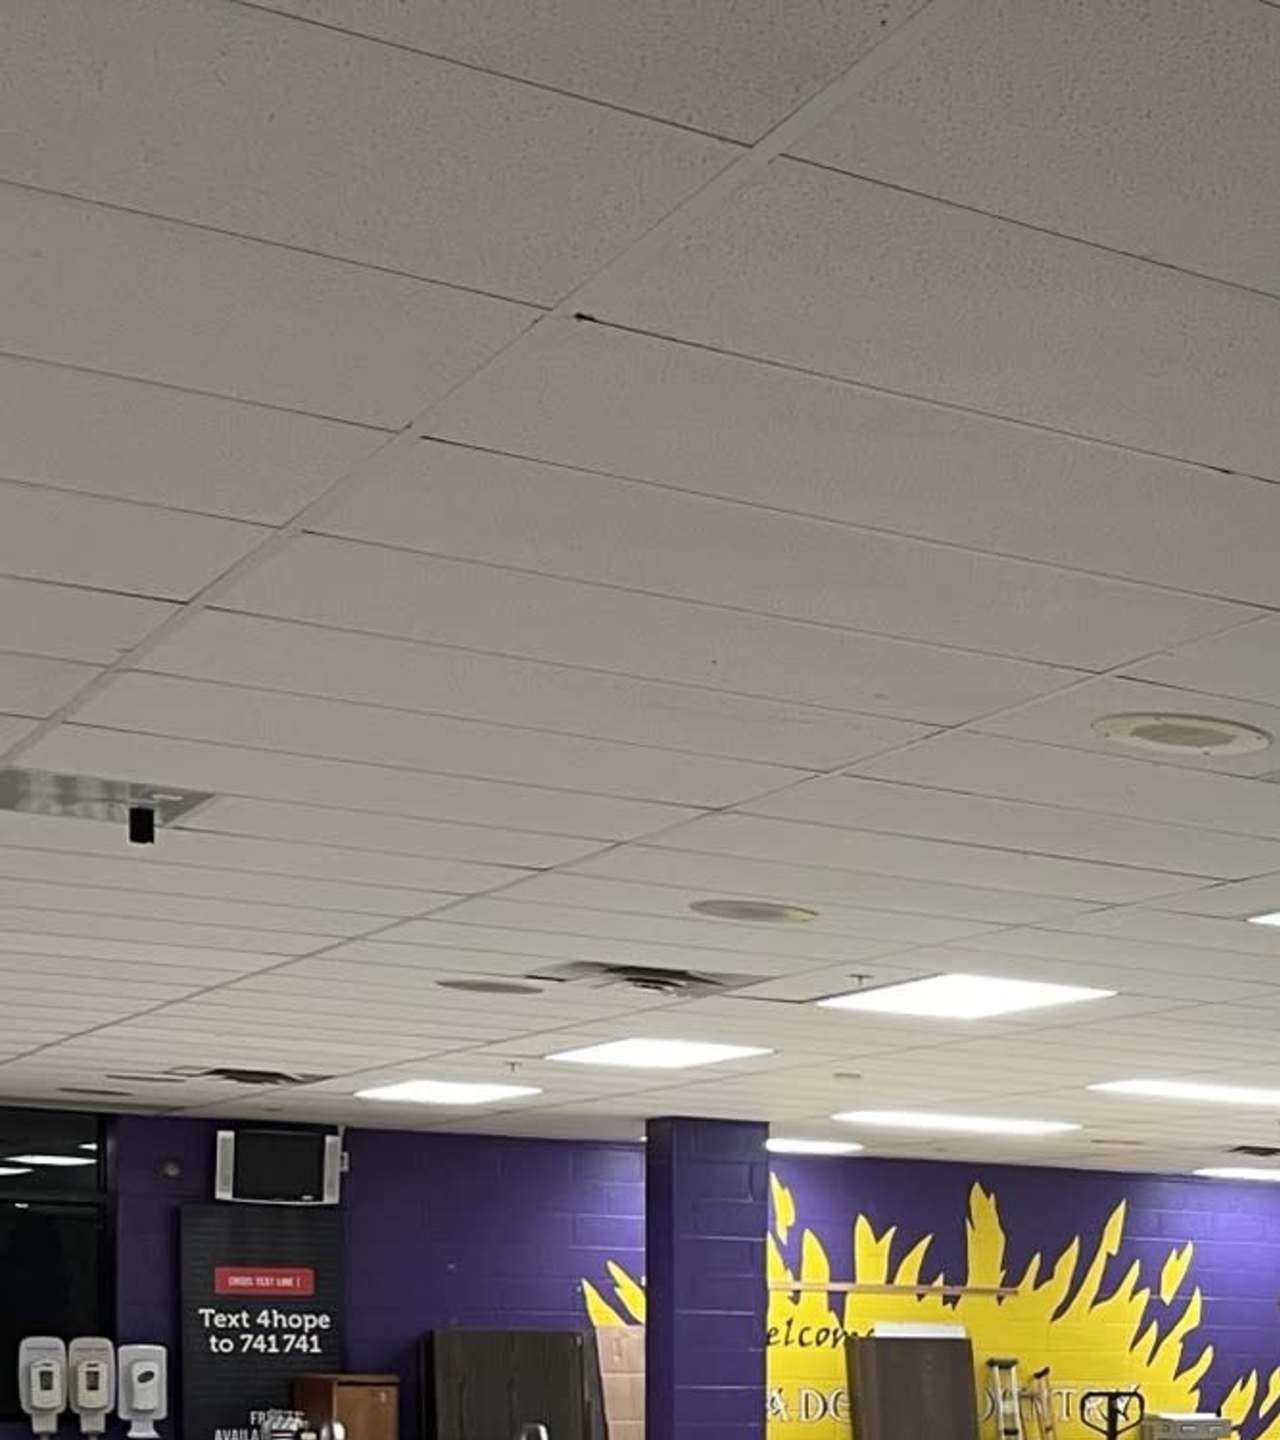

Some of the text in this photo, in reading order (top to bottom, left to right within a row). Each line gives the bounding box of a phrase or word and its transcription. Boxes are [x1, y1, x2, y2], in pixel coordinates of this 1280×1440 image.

[198, 1308, 331, 1333] Text 4hope
[209, 1335, 234, 1353] to
